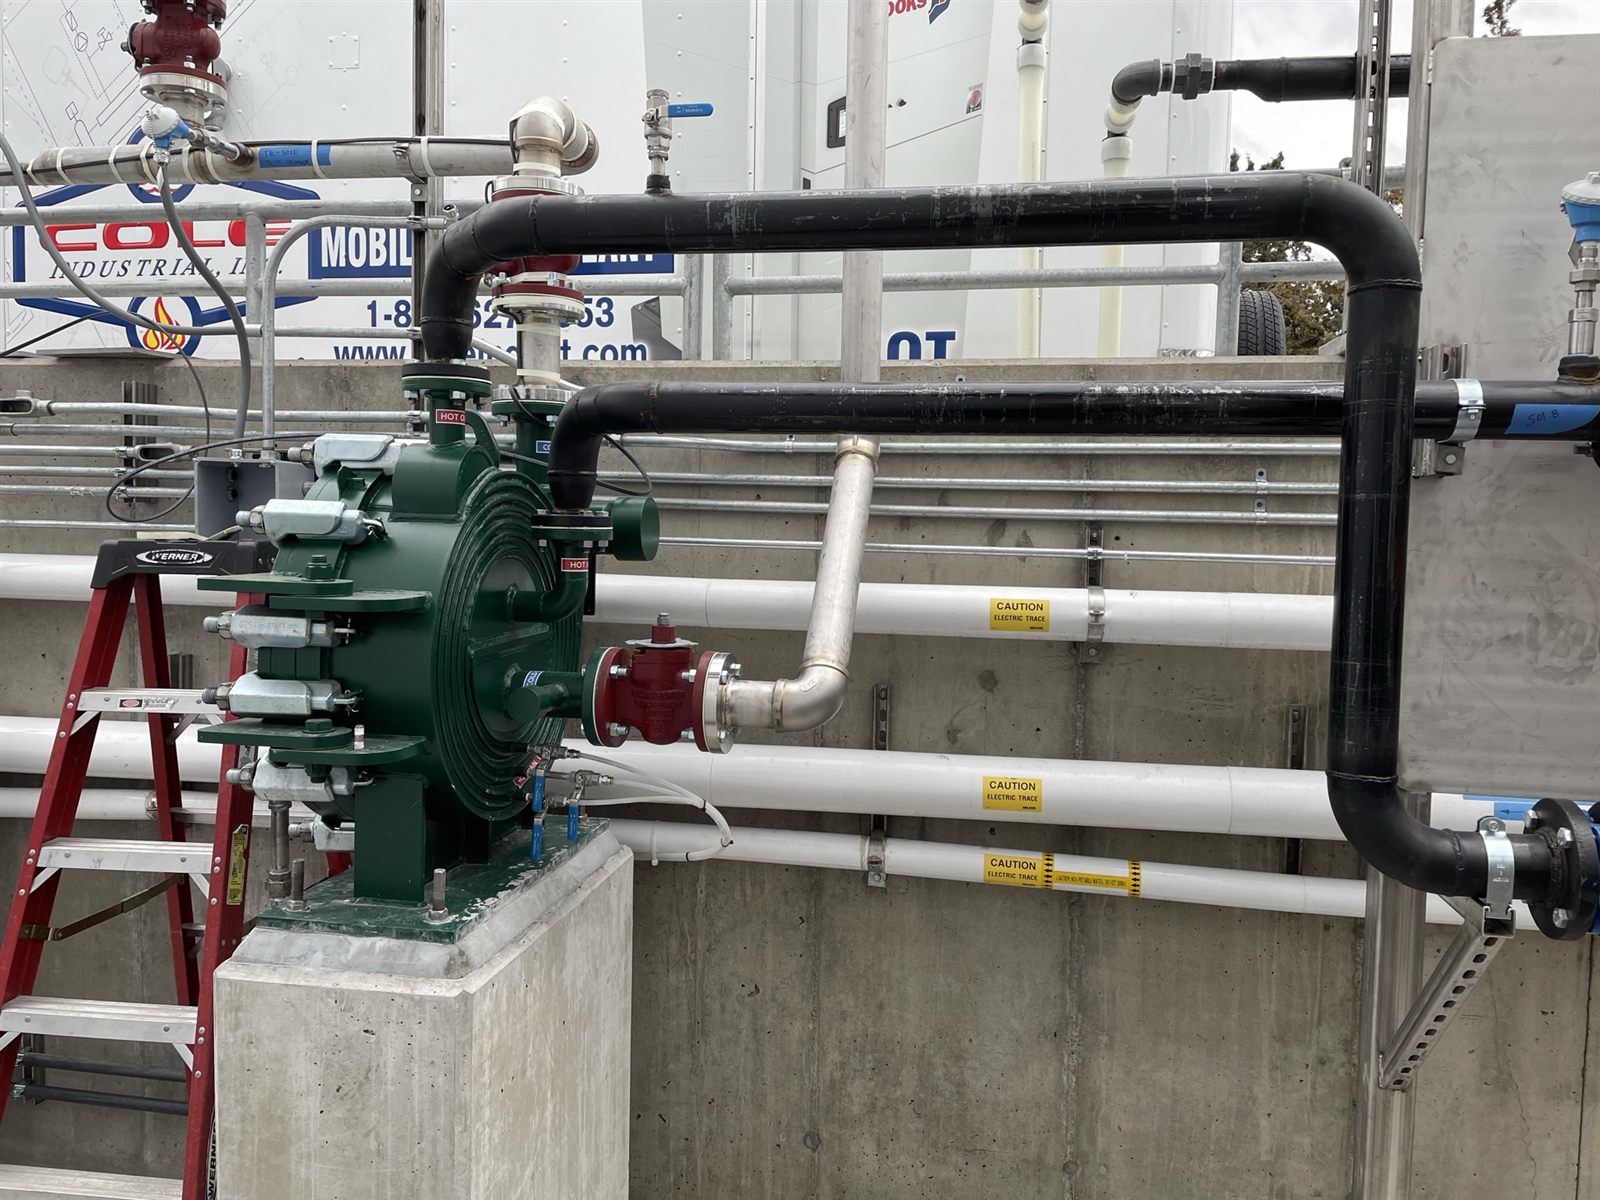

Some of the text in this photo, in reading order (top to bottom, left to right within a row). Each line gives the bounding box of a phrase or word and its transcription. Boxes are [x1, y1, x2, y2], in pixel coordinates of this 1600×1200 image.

[321, 226, 413, 267] MOBIL
[440, 412, 459, 421] HOT
[570, 561, 586, 569] HOT
[996, 601, 1043, 611] CAUTION
[989, 780, 1036, 791] CAUTION
[987, 793, 1038, 802] ELECTRIC TRACE
[990, 858, 1036, 870] CAUTION
[987, 870, 1038, 881] ELECTRIC TRACE
